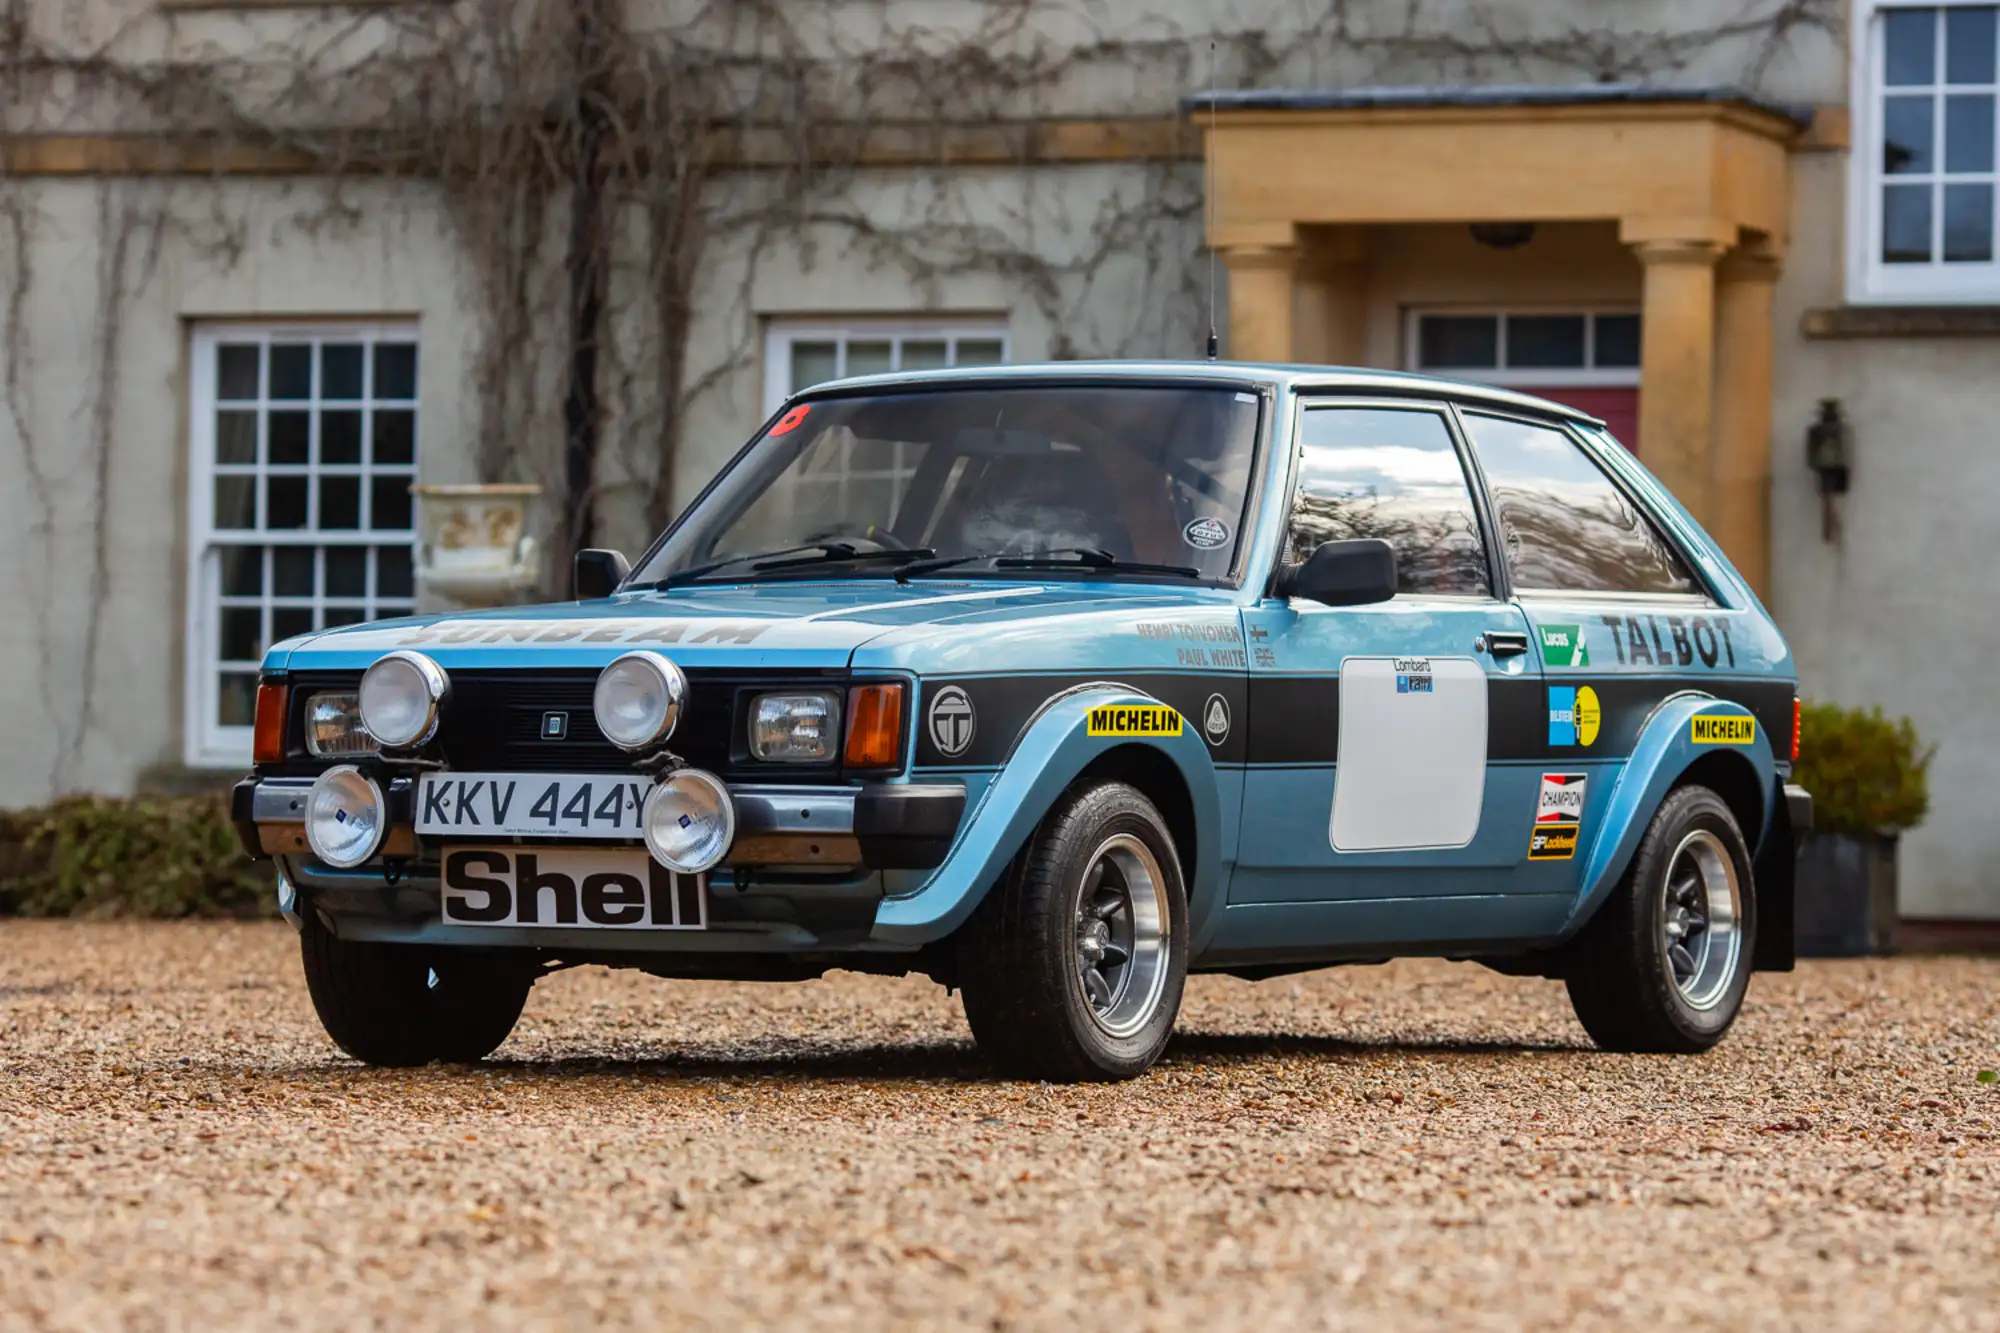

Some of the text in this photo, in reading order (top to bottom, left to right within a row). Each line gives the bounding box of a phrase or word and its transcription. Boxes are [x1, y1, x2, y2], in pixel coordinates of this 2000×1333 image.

[1191, 528, 1224, 538] LOTUS
[1136, 623, 1241, 643] HENRI TOIVONEN
[1601, 615, 1735, 668] TALBOT
[1176, 647, 1246, 667] PAUL WHITE
[1392, 658, 1431, 673] Lombard
[1092, 710, 1179, 732] MICHELIN
[1209, 721, 1226, 731] LOTUS
[1695, 719, 1753, 739] MICHELIN
[423, 780, 653, 828] KKV 444Y
[1542, 791, 1581, 807] CHAMPION
[446, 850, 702, 926] Shell
